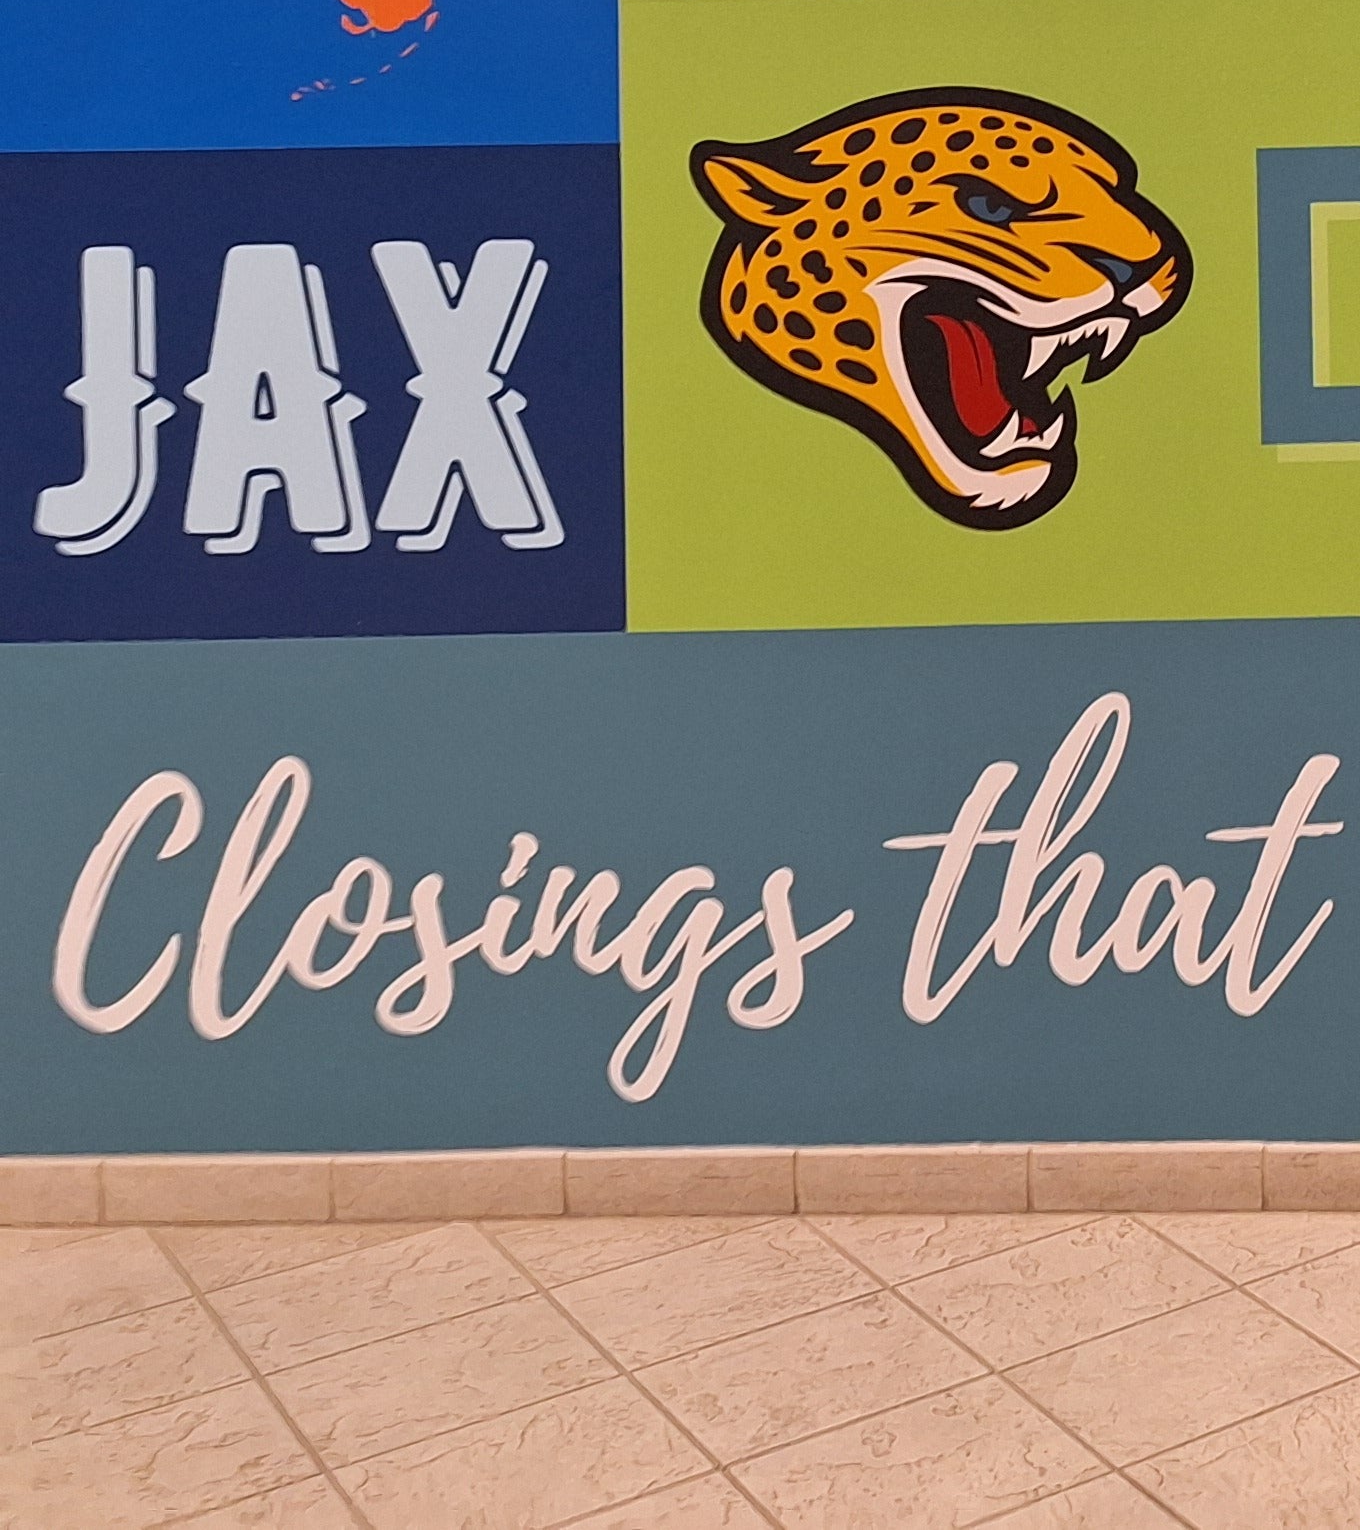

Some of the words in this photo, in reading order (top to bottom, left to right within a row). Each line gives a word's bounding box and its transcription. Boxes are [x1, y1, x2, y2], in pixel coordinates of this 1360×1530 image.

[34, 238, 566, 557] JAX
[51, 754, 856, 1104] Closings
[881, 690, 1345, 1025] that
